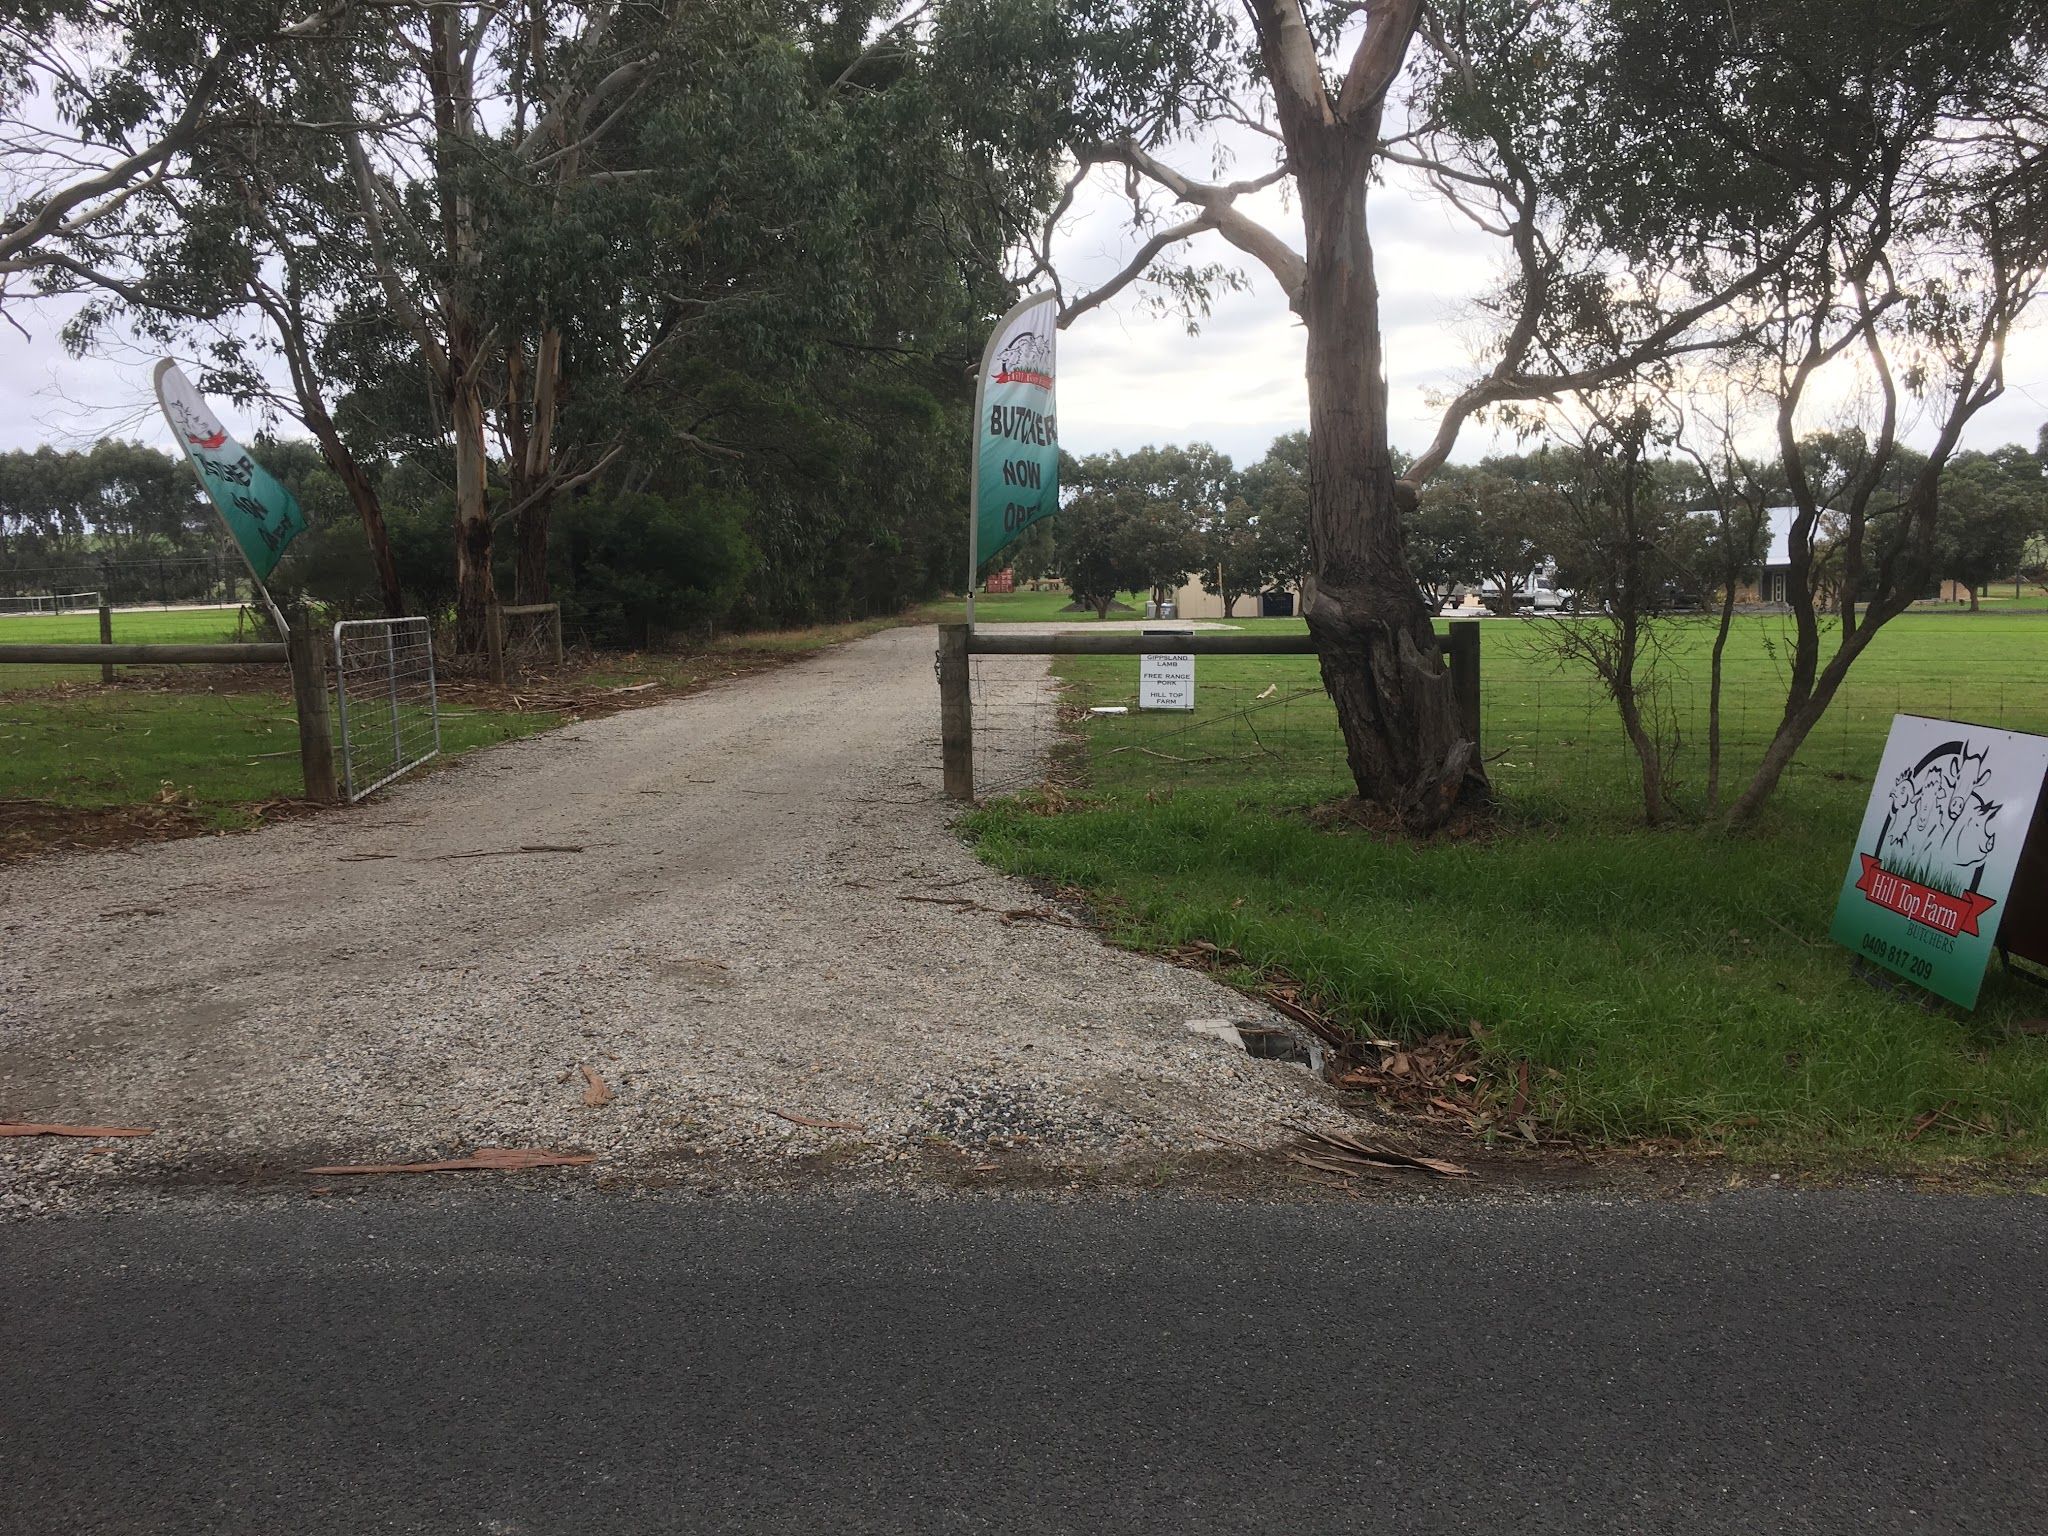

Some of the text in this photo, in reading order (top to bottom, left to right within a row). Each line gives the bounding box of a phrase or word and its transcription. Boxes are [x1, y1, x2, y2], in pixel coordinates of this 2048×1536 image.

[1002, 459, 1041, 490] NOW
[1870, 873, 1959, 931] Hill Top Farm
[1862, 933, 1933, 981] 0409 817 209
[1905, 922, 1957, 955] BUTCHERS
